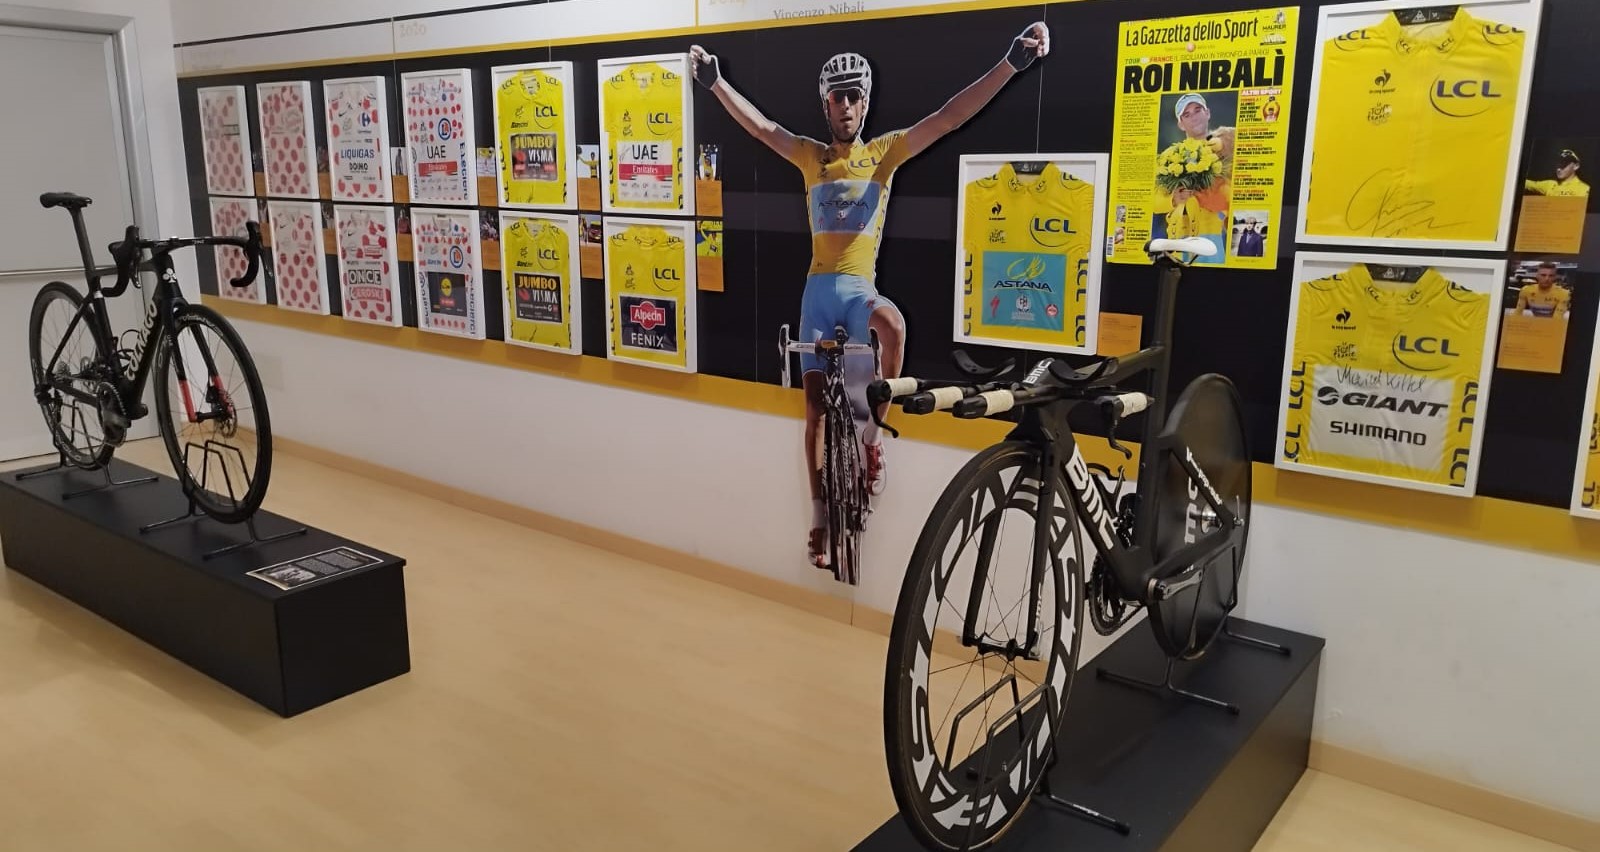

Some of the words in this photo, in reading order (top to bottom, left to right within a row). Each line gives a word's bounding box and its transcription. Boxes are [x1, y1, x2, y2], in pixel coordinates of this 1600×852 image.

[773, 8, 825, 21] Vincenzo
[829, 1, 865, 16] Nibali
[1126, 30, 1139, 46] La
[1140, 24, 1191, 45] Gazzetta
[1193, 21, 1222, 41] dello
[1223, 17, 1259, 42] Sport
[1123, 63, 1174, 94] ROI
[1178, 48, 1285, 91] NIBALÌ
[1436, 80, 1502, 98] LCL
[535, 106, 558, 117] LCL
[648, 113, 673, 124] LCL
[514, 135, 554, 149] JUMBO
[340, 148, 375, 160] LIQUIGAS
[427, 145, 447, 159] UAE
[528, 149, 554, 162] VISMA
[632, 145, 659, 160] UAE
[632, 164, 660, 174] Emirates
[849, 155, 881, 168] LCL
[817, 200, 870, 210] ASTANA
[1033, 216, 1077, 234] LCL
[538, 248, 560, 260] LCL
[349, 270, 382, 285] ONCE
[654, 268, 680, 281] LCL
[1076, 258, 1089, 302] LCL
[518, 275, 557, 291] JUMBO
[993, 280, 1053, 293] ASTANA
[532, 289, 558, 304] VISMA
[633, 310, 662, 323] Alpecin
[126, 302, 158, 381] COLNAGO
[630, 332, 664, 348] FENIX
[1398, 335, 1460, 357] LCL
[1022, 358, 1056, 385] BMC
[1289, 360, 1307, 411] LCL
[1341, 391, 1449, 418] GIANT
[1457, 381, 1479, 434] LCL
[1329, 420, 1427, 447] SHIMANO
[1064, 443, 1114, 551] BMC
